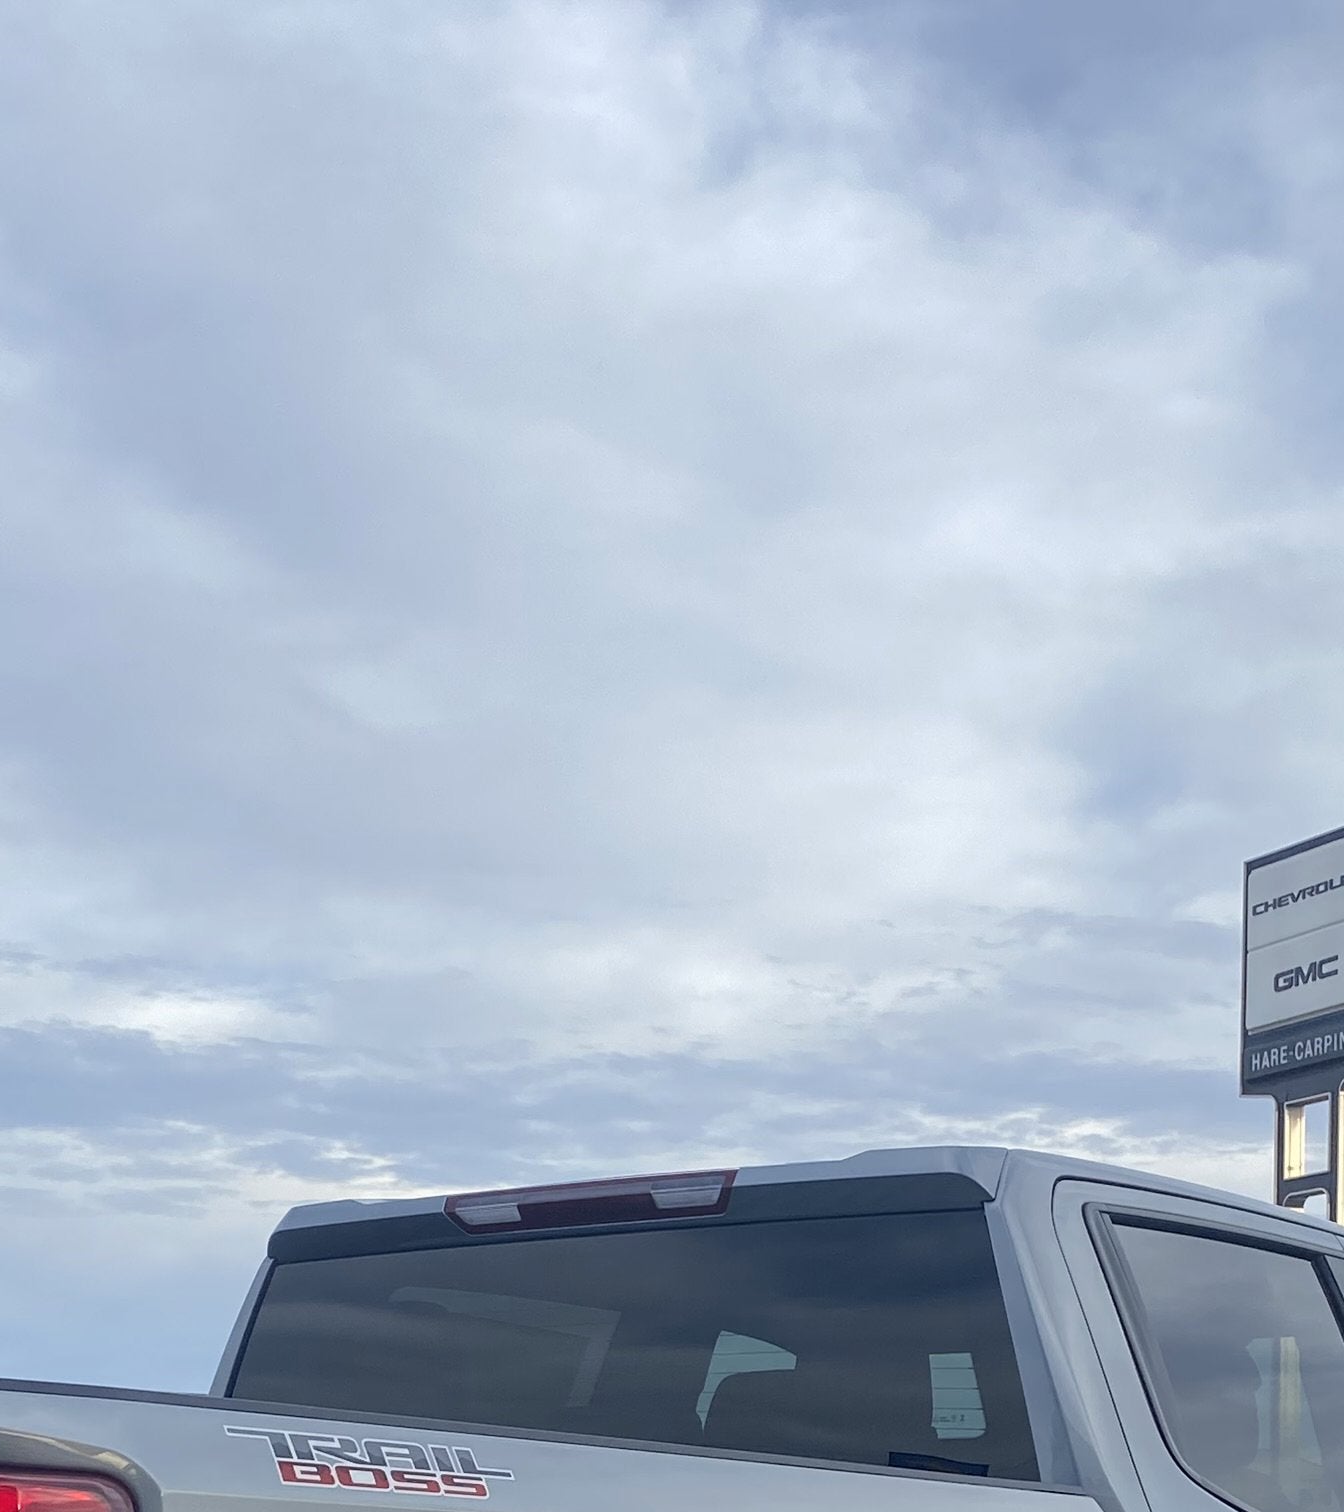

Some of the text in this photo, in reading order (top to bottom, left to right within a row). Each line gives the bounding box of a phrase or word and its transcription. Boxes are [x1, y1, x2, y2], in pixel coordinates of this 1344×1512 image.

[1273, 954, 1339, 994] GMC
[223, 1425, 515, 1480] TRAIL
[275, 1459, 490, 1500] BOSS
